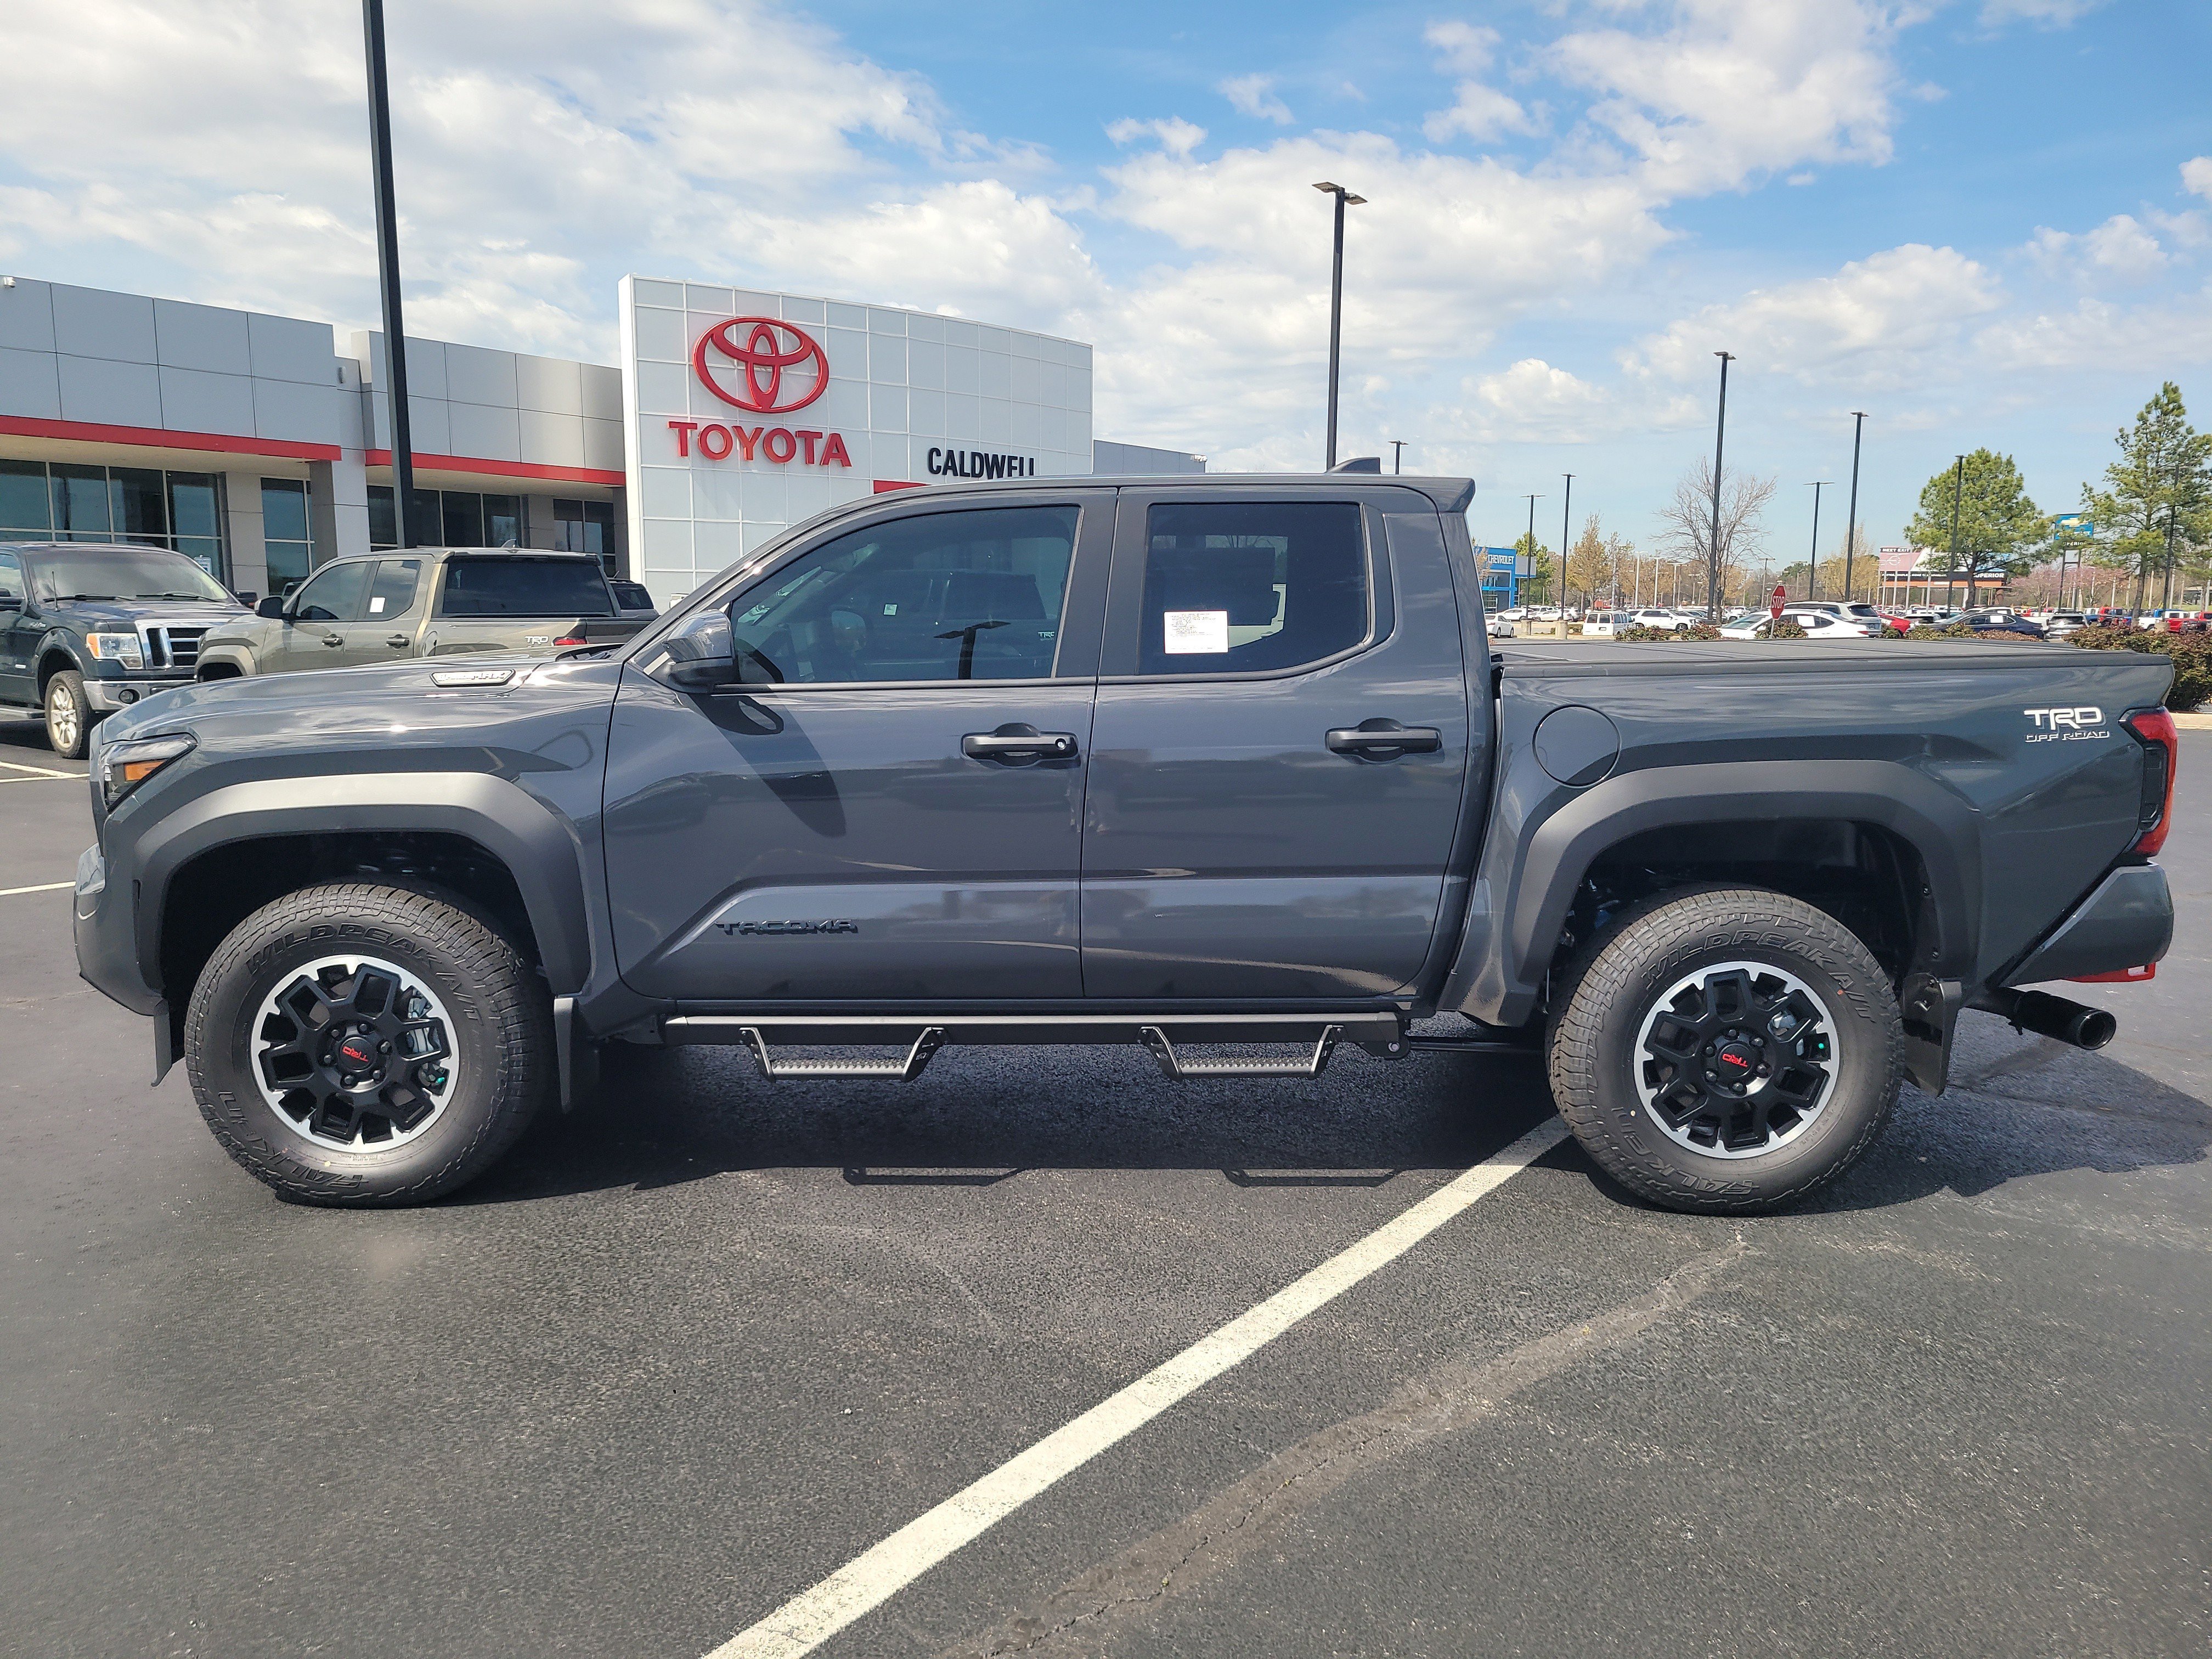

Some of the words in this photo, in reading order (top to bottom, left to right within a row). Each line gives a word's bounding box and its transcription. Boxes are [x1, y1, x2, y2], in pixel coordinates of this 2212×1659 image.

[667, 421, 852, 467] TOYOTA
[1487, 554, 1514, 565] CHEVROLET
[1771, 595, 1785, 609] STOP
[525, 636, 549, 645] TRD
[2023, 707, 2103, 731] TRD
[2025, 733, 2059, 743] OFF
[2062, 731, 2110, 741] ROAD
[714, 919, 858, 935] TACOMA
[245, 923, 443, 975] WILDPEAK
[1640, 929, 1837, 990] WILDPEAK
[342, 1046, 369, 1062] TRD
[1722, 1053, 1748, 1068] TRD
